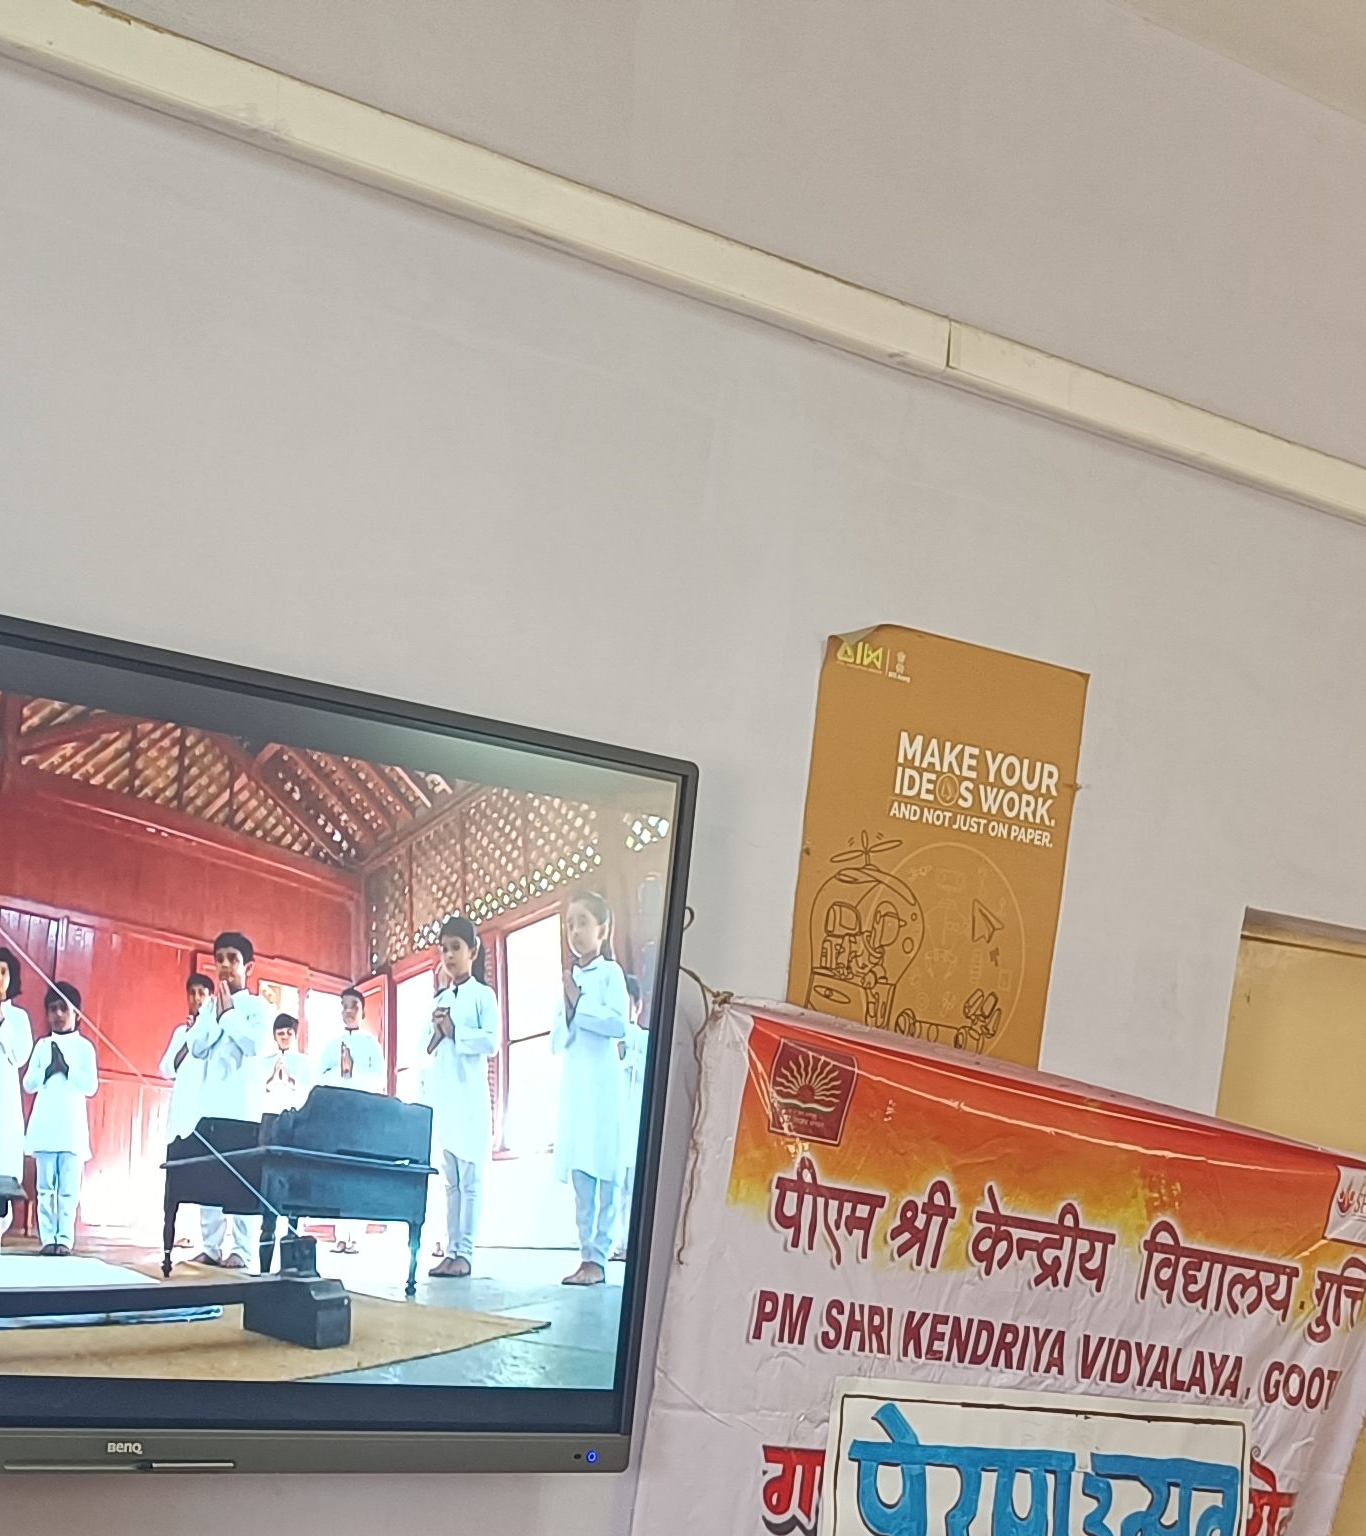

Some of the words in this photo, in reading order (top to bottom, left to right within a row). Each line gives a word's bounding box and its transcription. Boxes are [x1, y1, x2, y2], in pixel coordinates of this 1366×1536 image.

[897, 731, 980, 778] MAKE
[985, 750, 1059, 796] YOUR
[889, 801, 921, 821] AND
[922, 807, 953, 828] NOT
[952, 814, 987, 834] JUST
[988, 821, 1009, 838] ON
[1010, 825, 1053, 848] PAPER.
[979, 784, 1056, 827] WORK.
[775, 1156, 886, 1266] पीएम
[890, 1180, 957, 1269] श्री
[971, 1184, 1116, 1293] केन्द्रीय
[752, 1289, 813, 1346] PM
[821, 1299, 893, 1355] SHRI
[901, 1310, 1066, 1376] KENDRIYA
[1080, 1333, 1251, 1401] VIDYALAYA,
[1263, 1360, 1343, 1412] GOOT
[107, 1442, 143, 1455] BenQ
